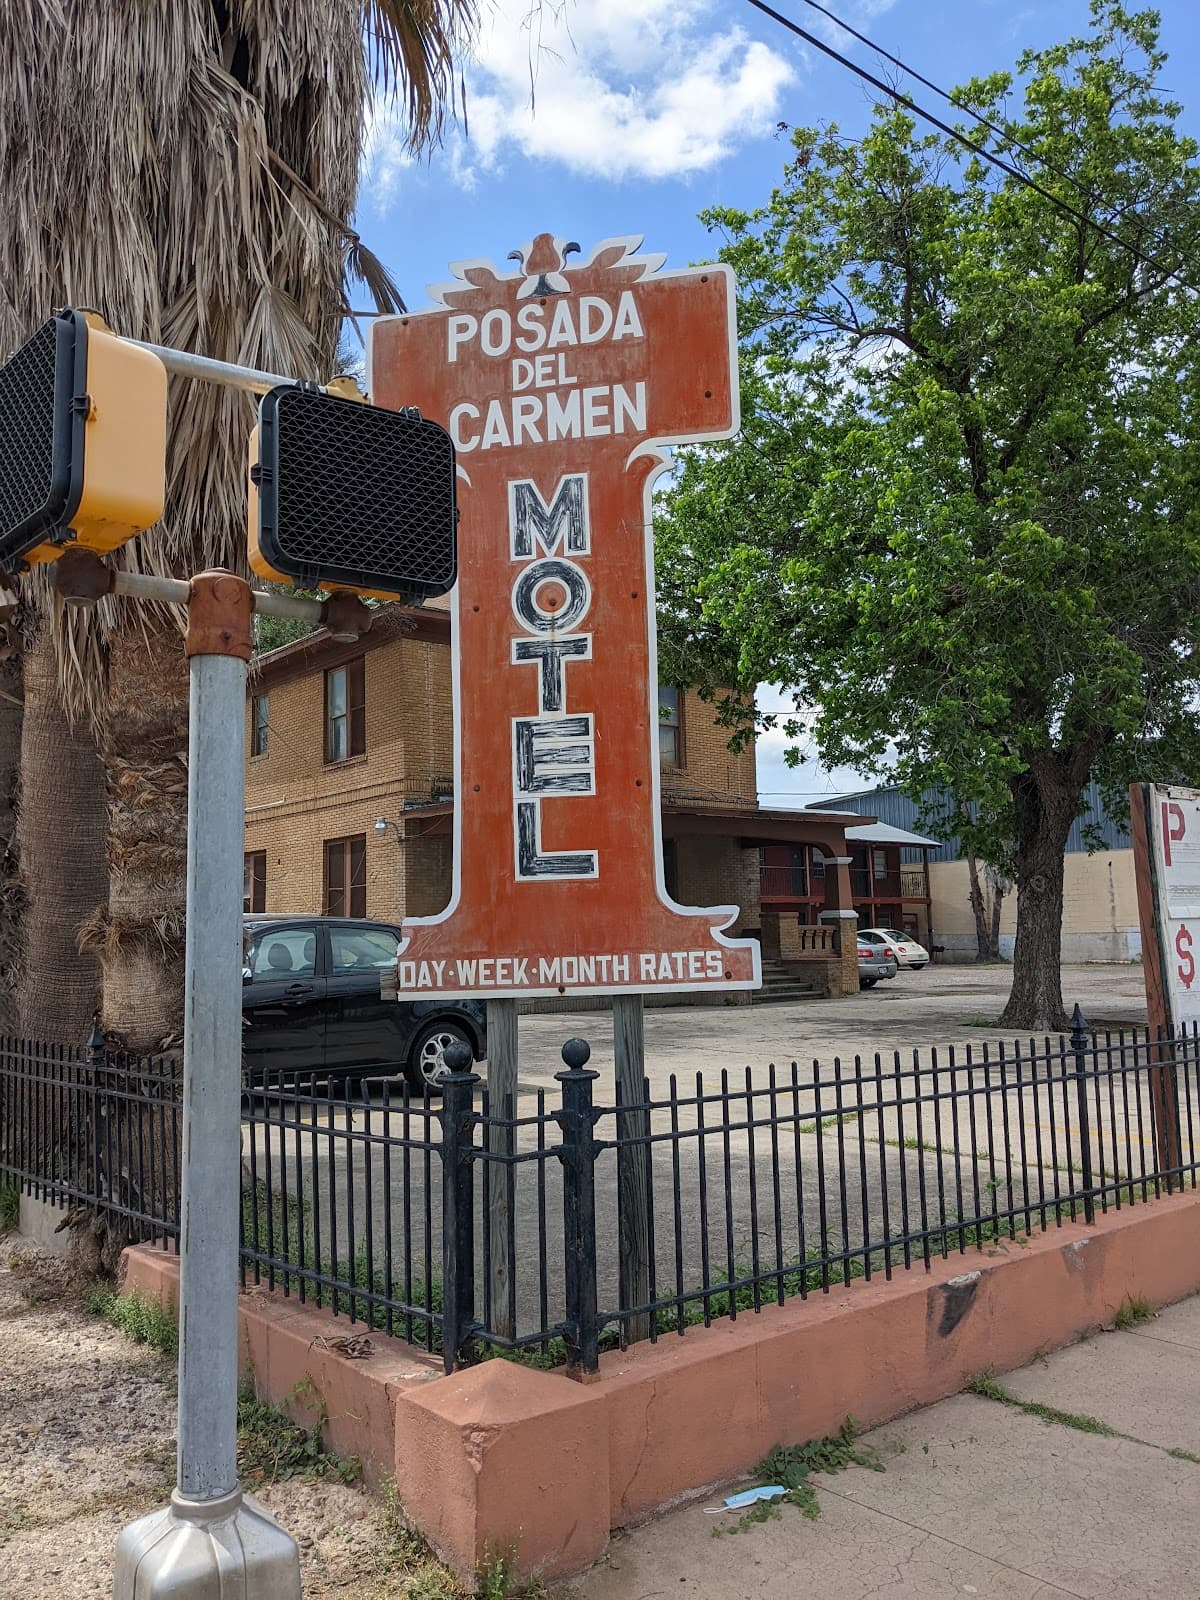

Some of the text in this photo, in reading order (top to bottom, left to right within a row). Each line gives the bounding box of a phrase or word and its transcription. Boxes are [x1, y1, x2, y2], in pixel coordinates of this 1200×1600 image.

[447, 290, 645, 362] POSADA
[511, 352, 578, 391] DEL
[449, 381, 647, 453] CARMEN
[507, 472, 600, 881] MOTEL
[1161, 802, 1186, 866] P
[640, 950, 724, 980] RATES
[1175, 923, 1195, 989] $
